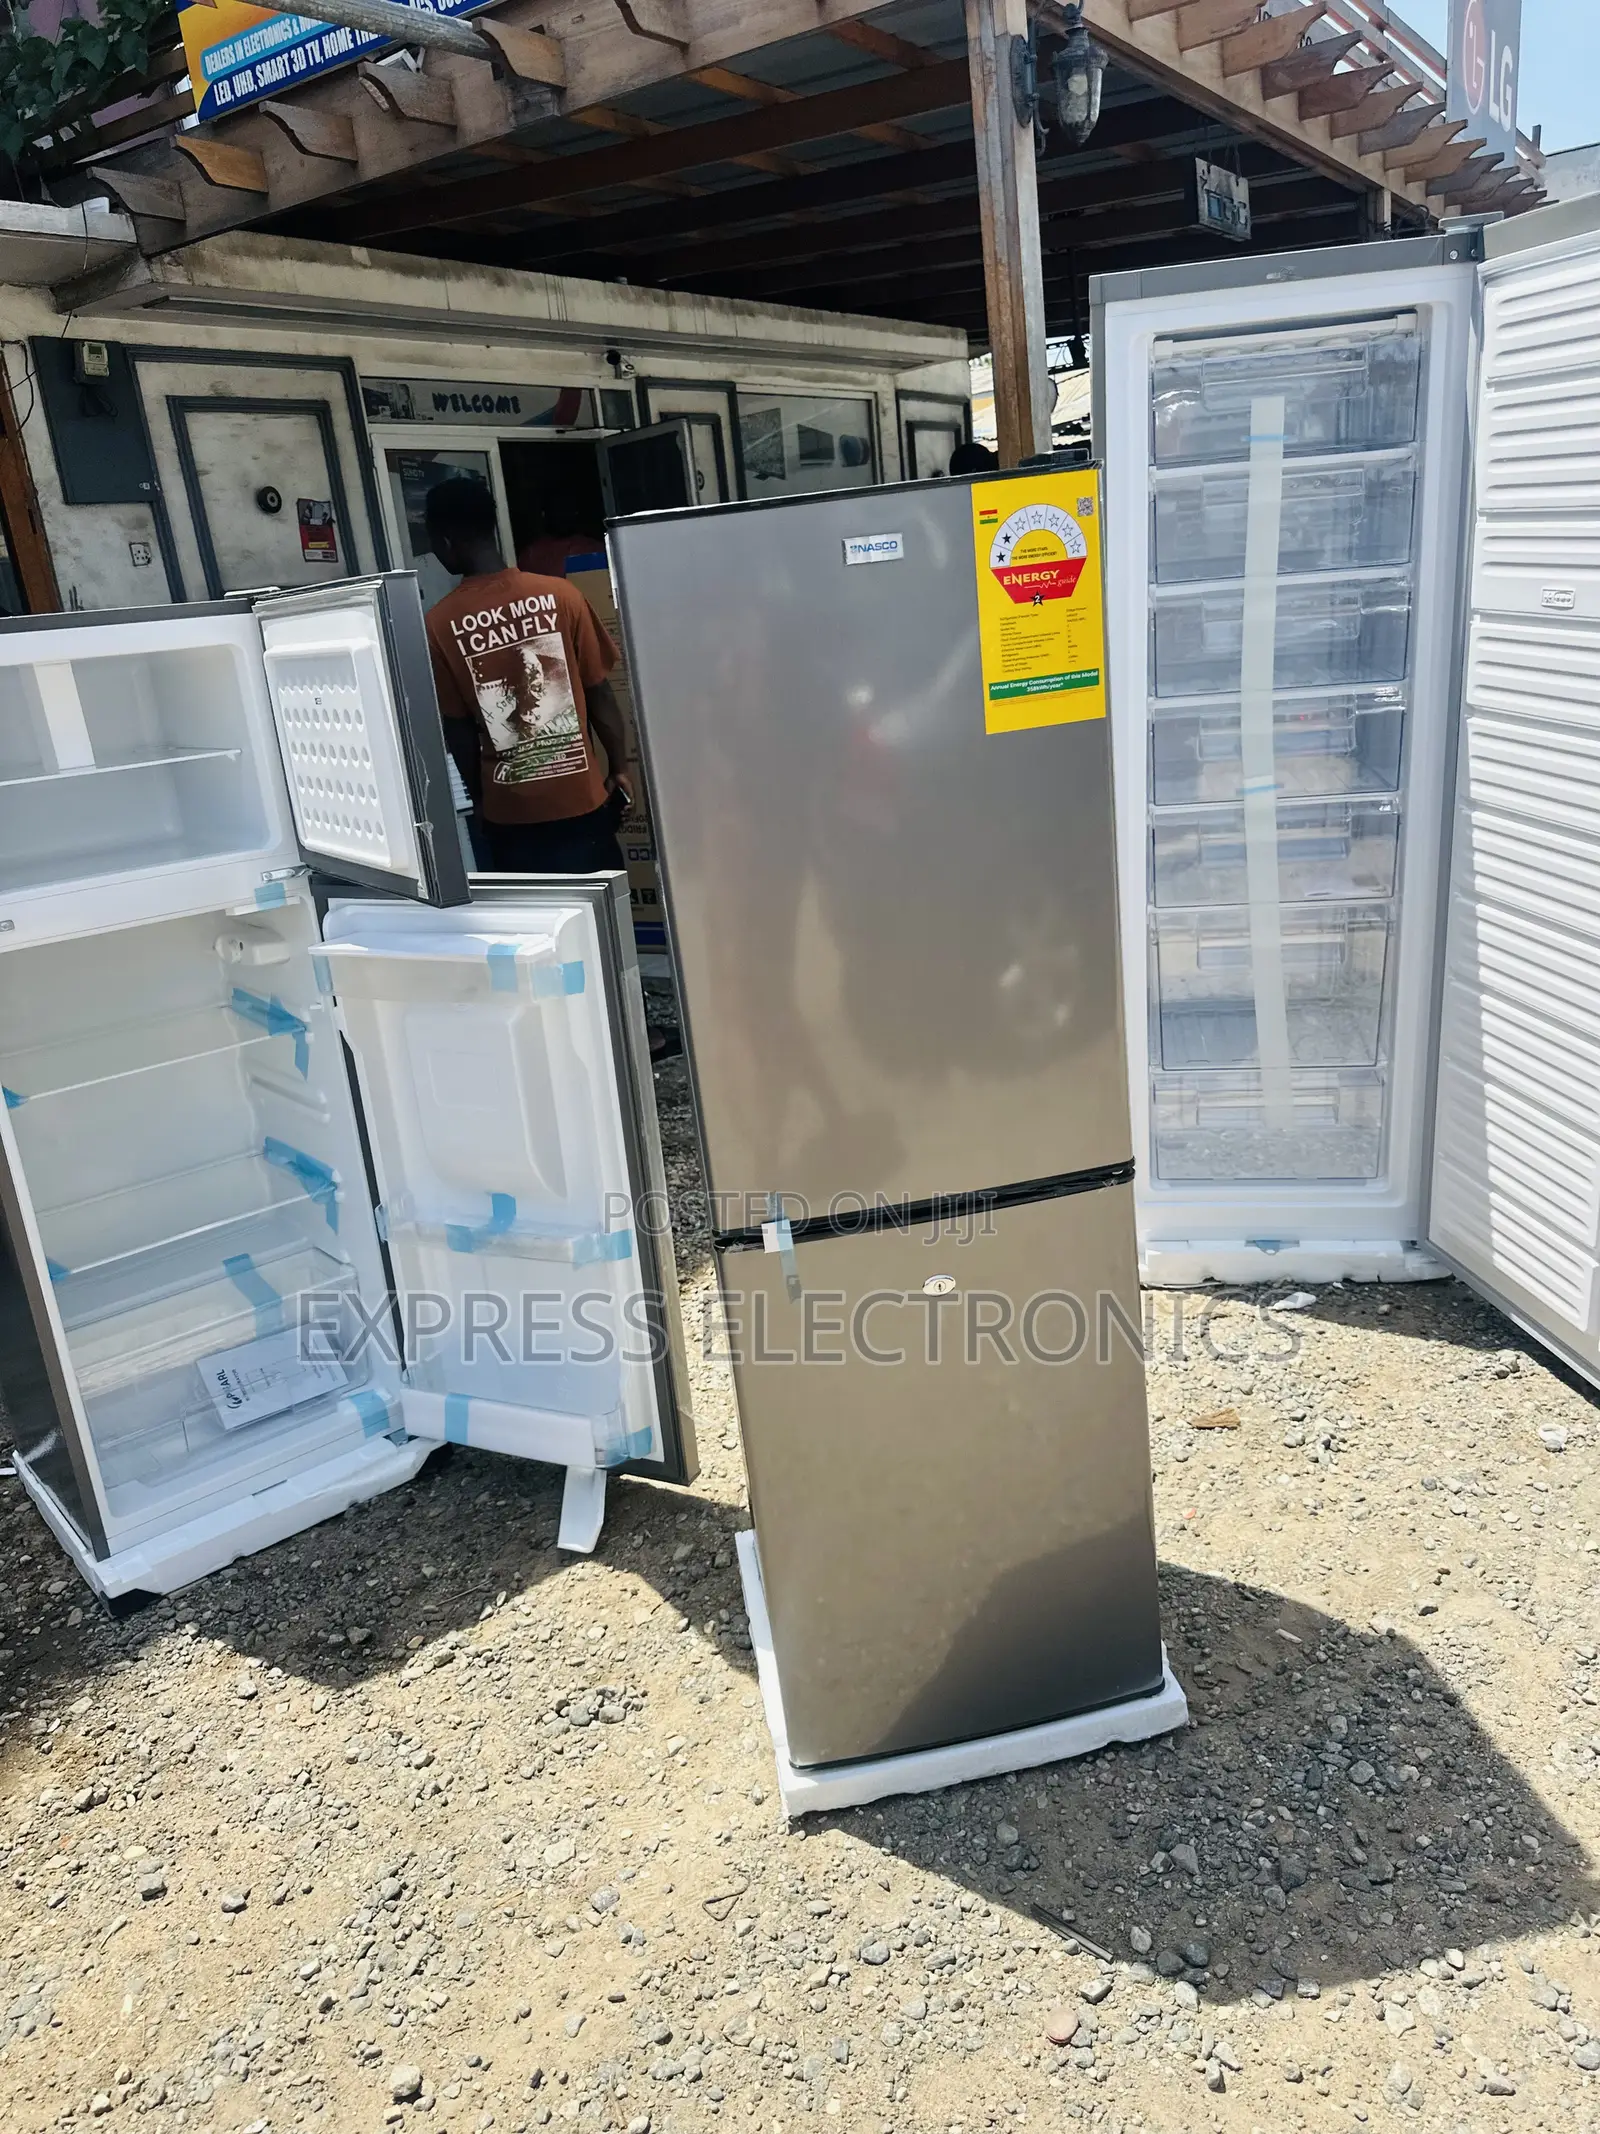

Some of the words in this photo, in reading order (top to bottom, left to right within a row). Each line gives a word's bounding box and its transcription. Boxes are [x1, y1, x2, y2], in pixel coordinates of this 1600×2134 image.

[204, 44, 236, 75] DEALERS
[234, 39, 245, 62] IN
[242, 18, 293, 58] ELECTRONICS
[292, 18, 300, 36] &
[298, 16, 323, 33] HO
[213, 80, 235, 106] LED,
[232, 69, 258, 98] UHD,
[255, 53, 291, 88] SMART
[290, 47, 307, 73] 3D
[305, 39, 325, 64] TV,
[321, 26, 355, 59] HOME
[1489, 29, 1513, 132] LG
[431, 392, 521, 414] WELCOME
[857, 541, 898, 553] NASCO
[1003, 569, 1060, 587] ENERGY
[1057, 574, 1076, 587] guide
[1034, 595, 1041, 603] 2
[450, 606, 506, 636] LOOK
[510, 594, 557, 616] MOM
[456, 638, 467, 656] I
[470, 624, 518, 652] CAN
[521, 613, 560, 637] FLY
[990, 683, 1009, 691] Annual
[1028, 676, 1064, 685] Consumption
